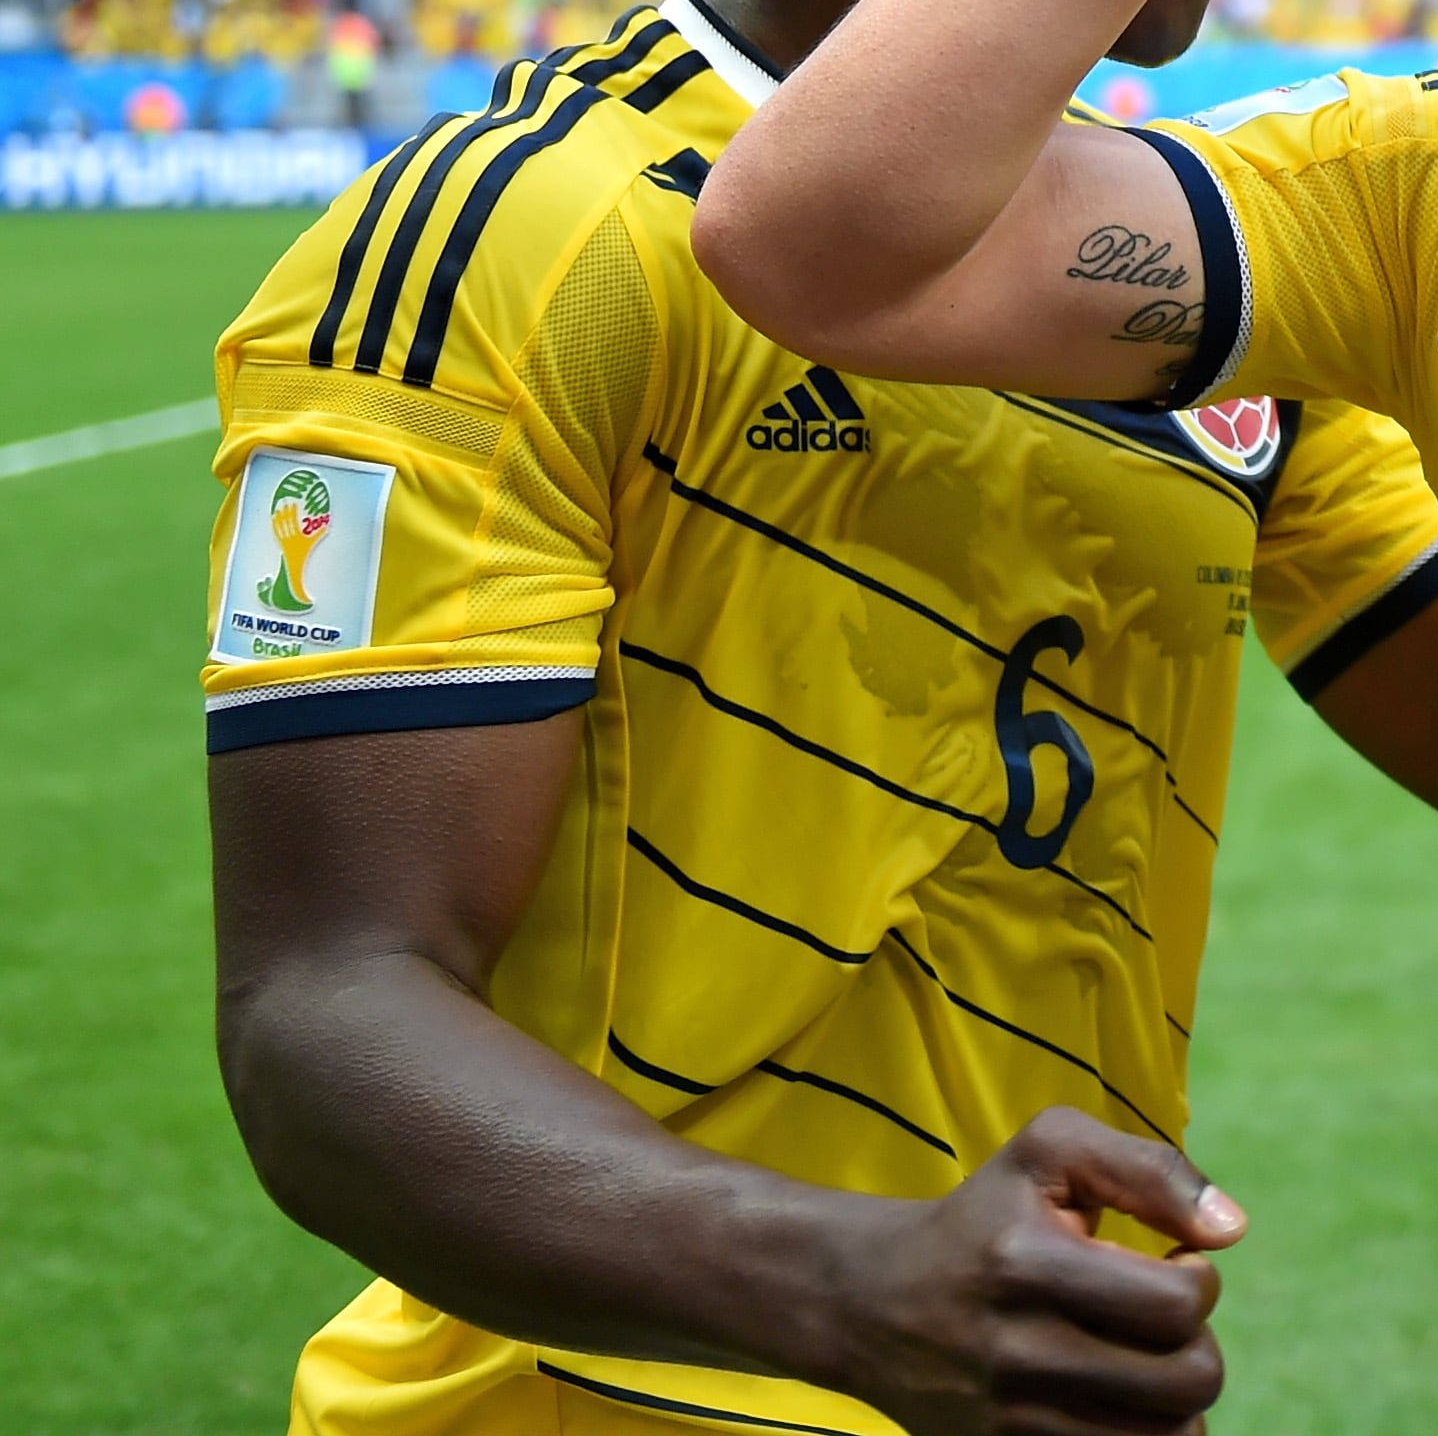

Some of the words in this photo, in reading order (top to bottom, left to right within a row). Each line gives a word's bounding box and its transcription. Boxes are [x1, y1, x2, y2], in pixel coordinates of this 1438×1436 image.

[1066, 225, 1192, 289] Pilar
[302, 515, 330, 535] 2014
[231, 613, 254, 630] FIFA
[256, 616, 308, 639] WORLD
[310, 626, 341, 643] CUP
[253, 638, 302, 658] Brasil
[994, 613, 1095, 869] 6
